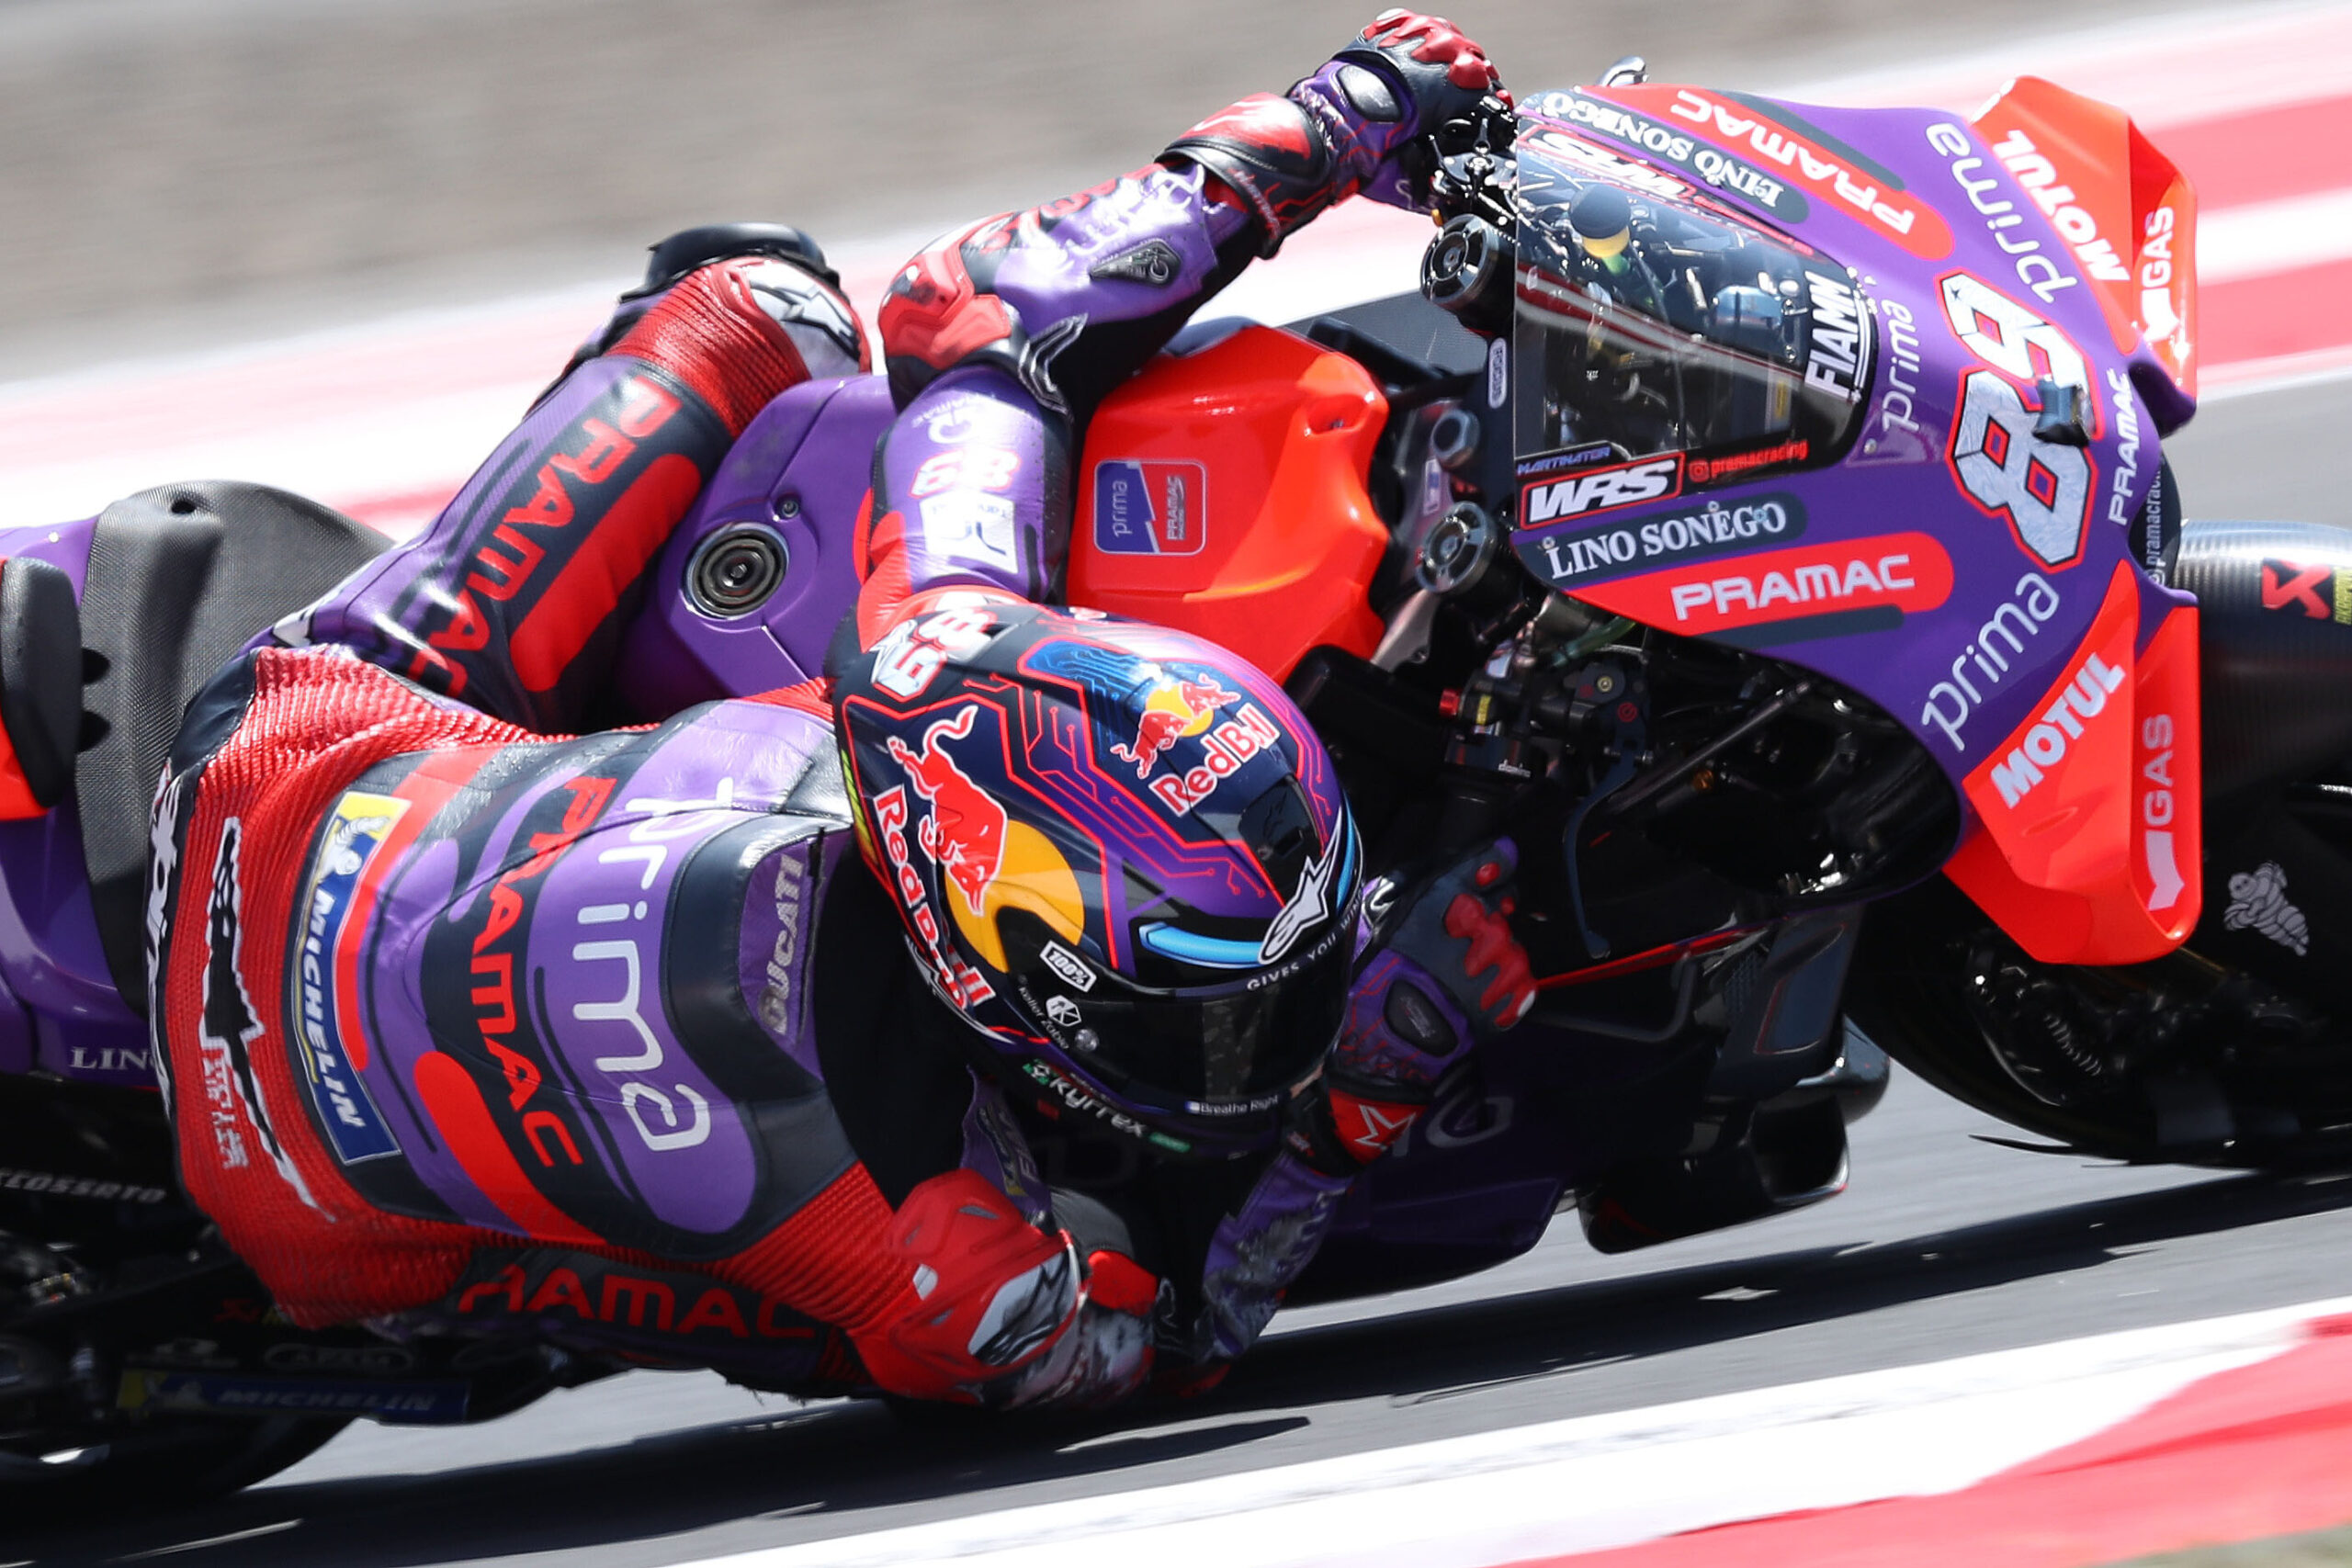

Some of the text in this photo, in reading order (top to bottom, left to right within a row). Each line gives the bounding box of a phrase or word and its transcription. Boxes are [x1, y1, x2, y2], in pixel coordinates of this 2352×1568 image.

[1670, 90, 1916, 234] PRAMAC
[1694, 151, 1785, 209] LINO
[1926, 122, 2078, 304] prima
[1992, 130, 2131, 282] MOTUL
[2143, 206, 2175, 288] GAS
[1804, 270, 1853, 396] FIAMM
[1881, 299, 1920, 432] prima
[1934, 266, 2105, 573] 89
[2108, 367, 2141, 525] PRAMAC
[407, 376, 683, 696] PRAMAC
[1111, 479, 1133, 537] prima
[1167, 476, 1180, 540] PRAMAC
[1529, 459, 1676, 523] WRS
[1546, 502, 1787, 580] LINO SONEGO
[1670, 554, 1916, 621] PRAMAC
[871, 606, 999, 704] 89
[1922, 572, 2061, 751] prima
[1990, 652, 2126, 809] MOTUL
[2143, 714, 2174, 826] GAS
[301, 886, 366, 1129] MICHELIN
[470, 776, 618, 1167] PRAMAC
[572, 776, 733, 1152] prima
[758, 853, 805, 1035] DUCATI
[1046, 946, 1090, 987] 100%
[69, 1047, 158, 1069] LIN
[218, 1388, 436, 1412] MICHELIN
